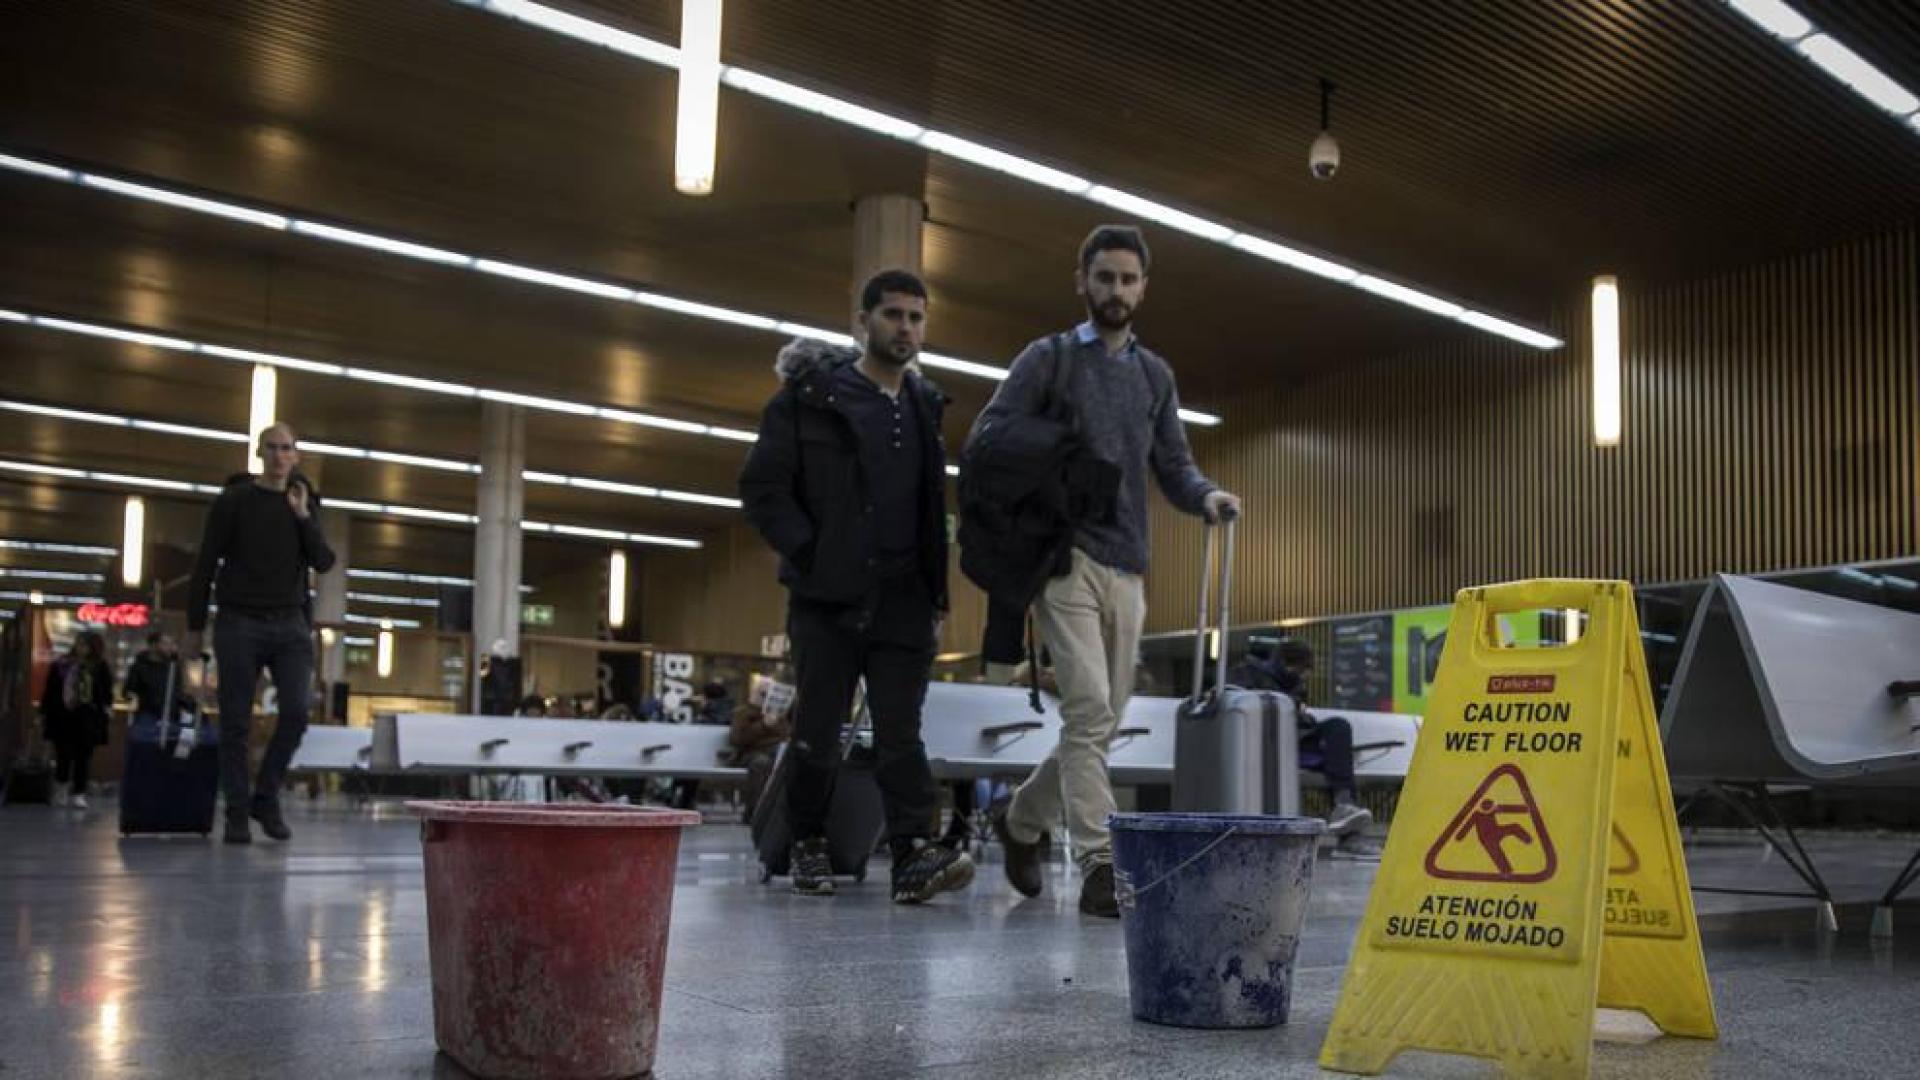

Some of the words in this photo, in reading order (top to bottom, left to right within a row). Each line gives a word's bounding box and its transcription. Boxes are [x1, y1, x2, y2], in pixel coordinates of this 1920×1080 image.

[1463, 702, 1571, 723] CAUTION
[1445, 732, 1495, 752] WET
[1504, 732, 1582, 753] FLOOR
[1419, 893, 1537, 920] ATENCIÓN
[1386, 916, 1459, 939] SUELO
[1464, 921, 1564, 948] MOJADO
